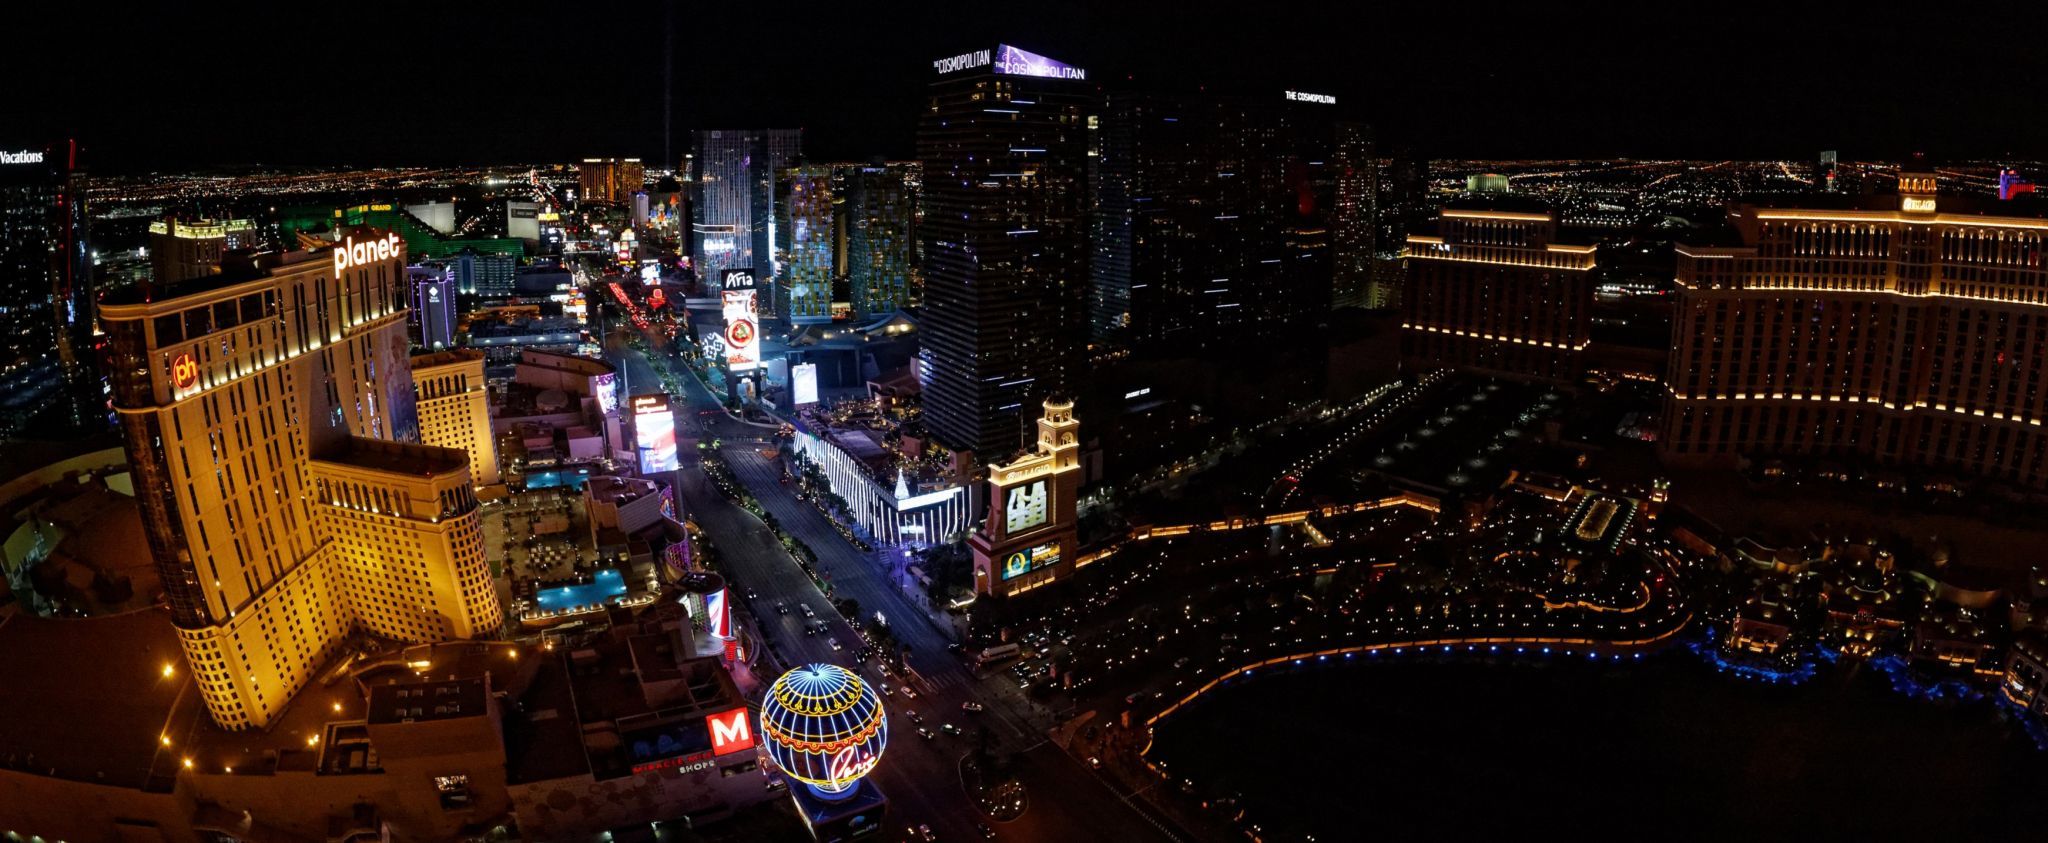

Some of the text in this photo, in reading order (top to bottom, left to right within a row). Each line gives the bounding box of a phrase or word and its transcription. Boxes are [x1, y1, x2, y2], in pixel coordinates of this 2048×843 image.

[938, 49, 990, 74] COSMOPOLITAN
[995, 61, 1006, 69] THE
[1285, 91, 1335, 103] THE COSMOPOLITAN
[0, 149, 44, 164] Vacations
[334, 232, 399, 279] planet
[725, 272, 754, 289] Aria
[176, 354, 197, 386] ph
[711, 712, 749, 747] M
[631, 756, 684, 774] MIRACLE
[679, 760, 715, 773] SHOPS
[831, 746, 876, 792] Paris
